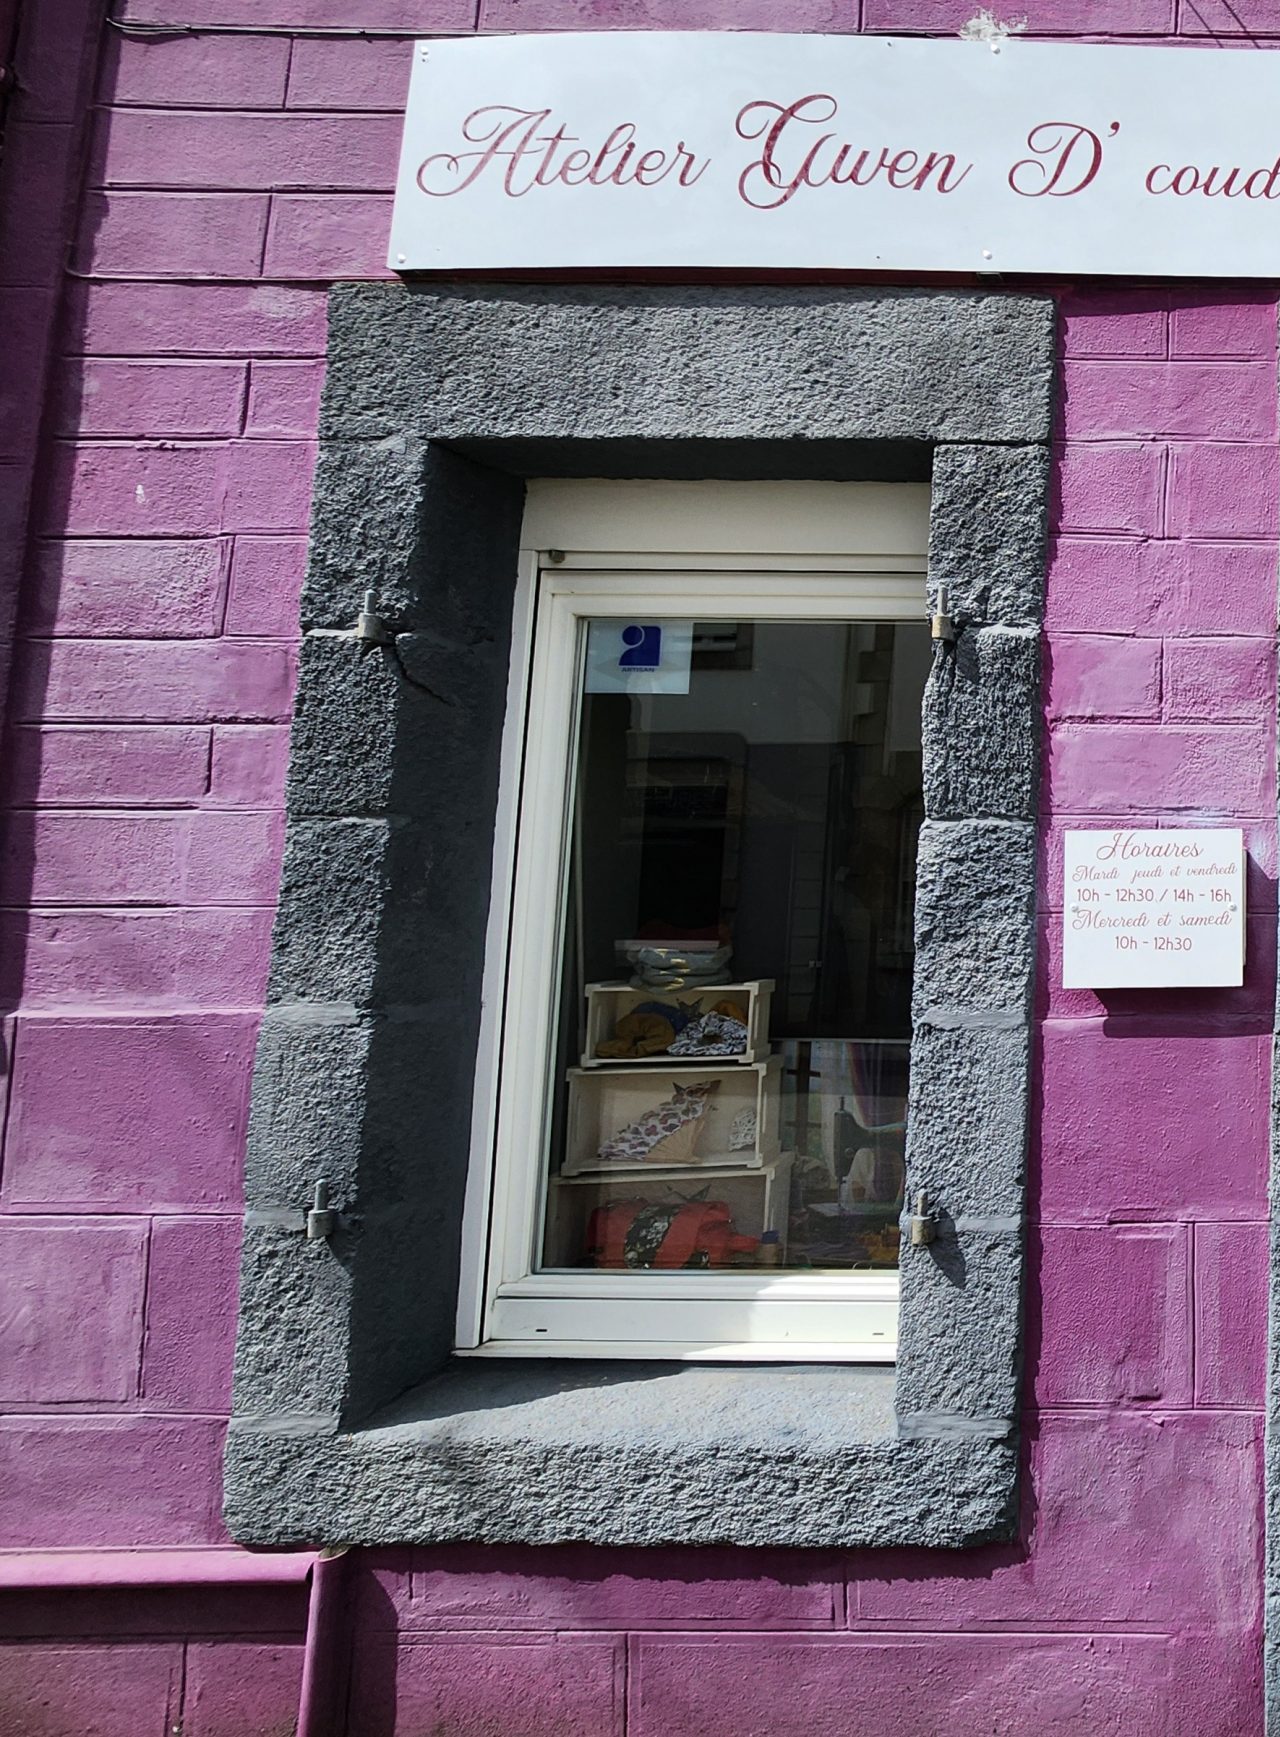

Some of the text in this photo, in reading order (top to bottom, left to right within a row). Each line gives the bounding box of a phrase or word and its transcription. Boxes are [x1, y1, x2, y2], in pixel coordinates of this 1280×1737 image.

[415, 105, 712, 198] Atelier
[1096, 832, 1204, 861] Horaires
[1071, 862, 1236, 885] Mardi jeudi et vendredi
[1076, 887, 1100, 902] 10h
[1115, 888, 1155, 902] 12h30
[1158, 888, 1169, 903] /
[1173, 888, 1195, 903] 14h
[1209, 888, 1232, 903] 16h
[1072, 909, 1232, 930] Mercredi et samedi
[1115, 935, 1138, 950] 10h
[1153, 936, 1193, 952] 12h30
